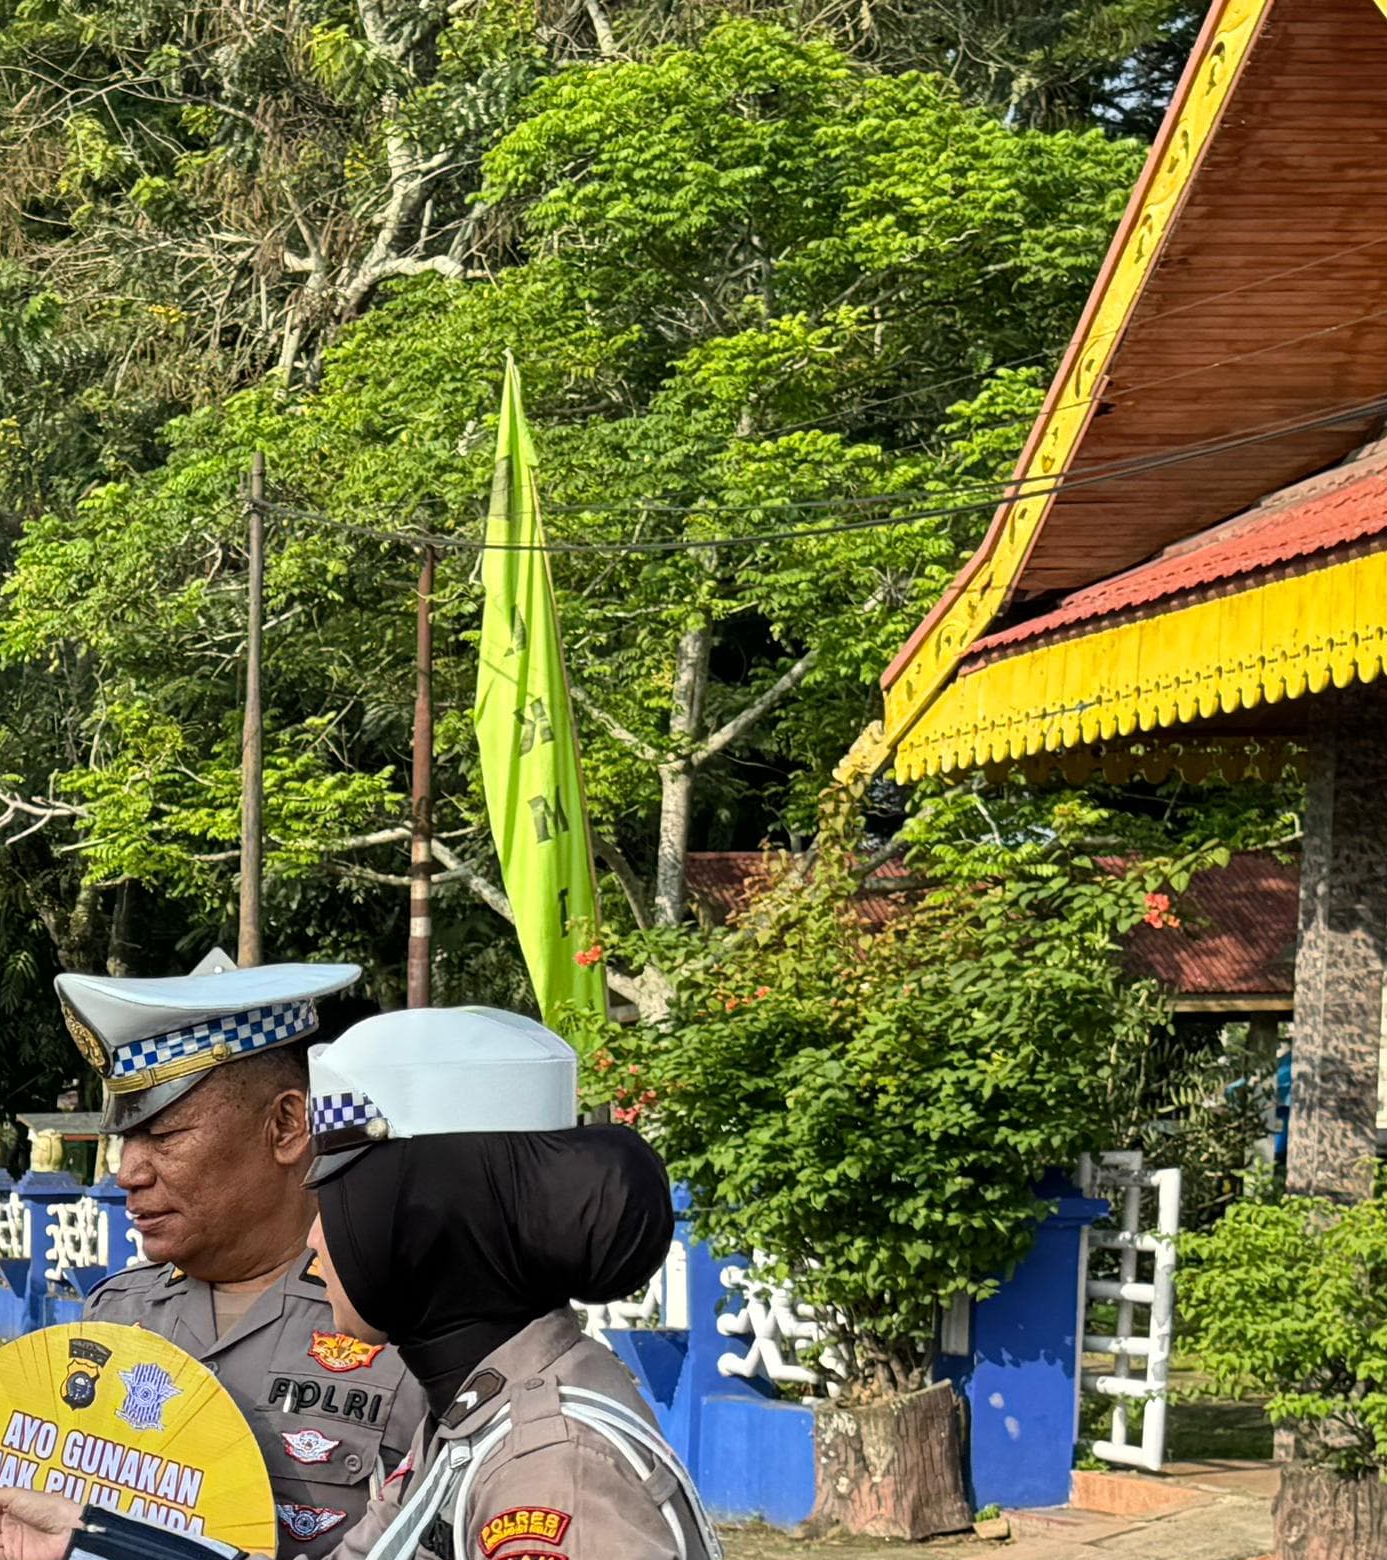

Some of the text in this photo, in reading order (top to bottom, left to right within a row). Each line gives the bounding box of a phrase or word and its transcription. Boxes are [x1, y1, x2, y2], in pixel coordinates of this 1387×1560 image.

[268, 1377, 383, 1424] POLRI
[1, 1410, 59, 1460] AYO
[61, 1429, 205, 1510] GUNAKAN
[481, 1510, 561, 1542] POLRES
